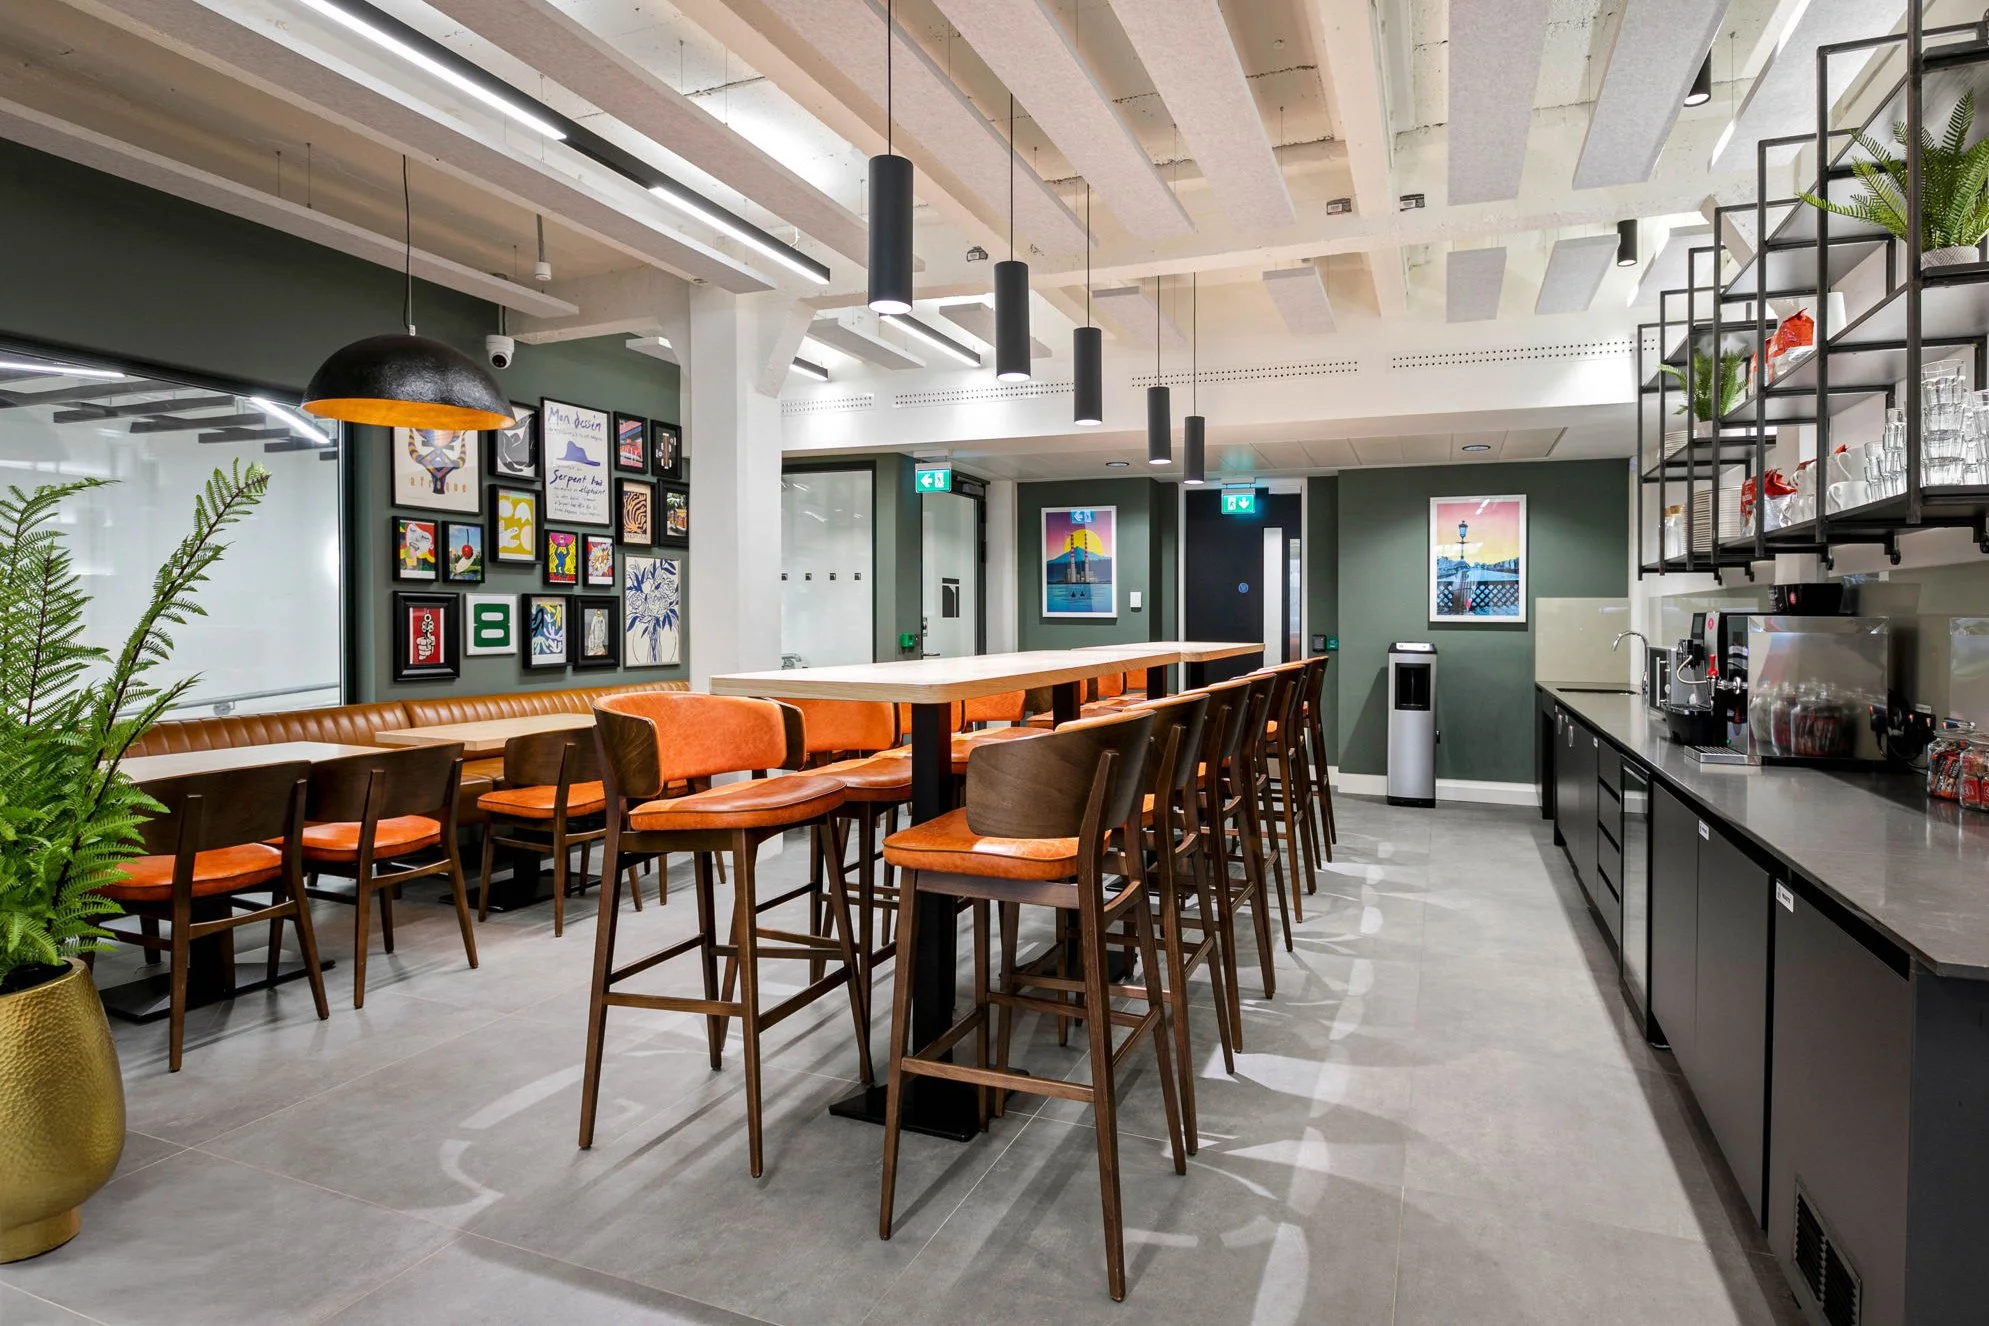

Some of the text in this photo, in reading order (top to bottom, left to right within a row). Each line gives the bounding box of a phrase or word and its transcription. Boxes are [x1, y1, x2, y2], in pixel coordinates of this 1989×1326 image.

[548, 407, 601, 432] Mon dessin
[549, 469, 587, 488] Serpent
